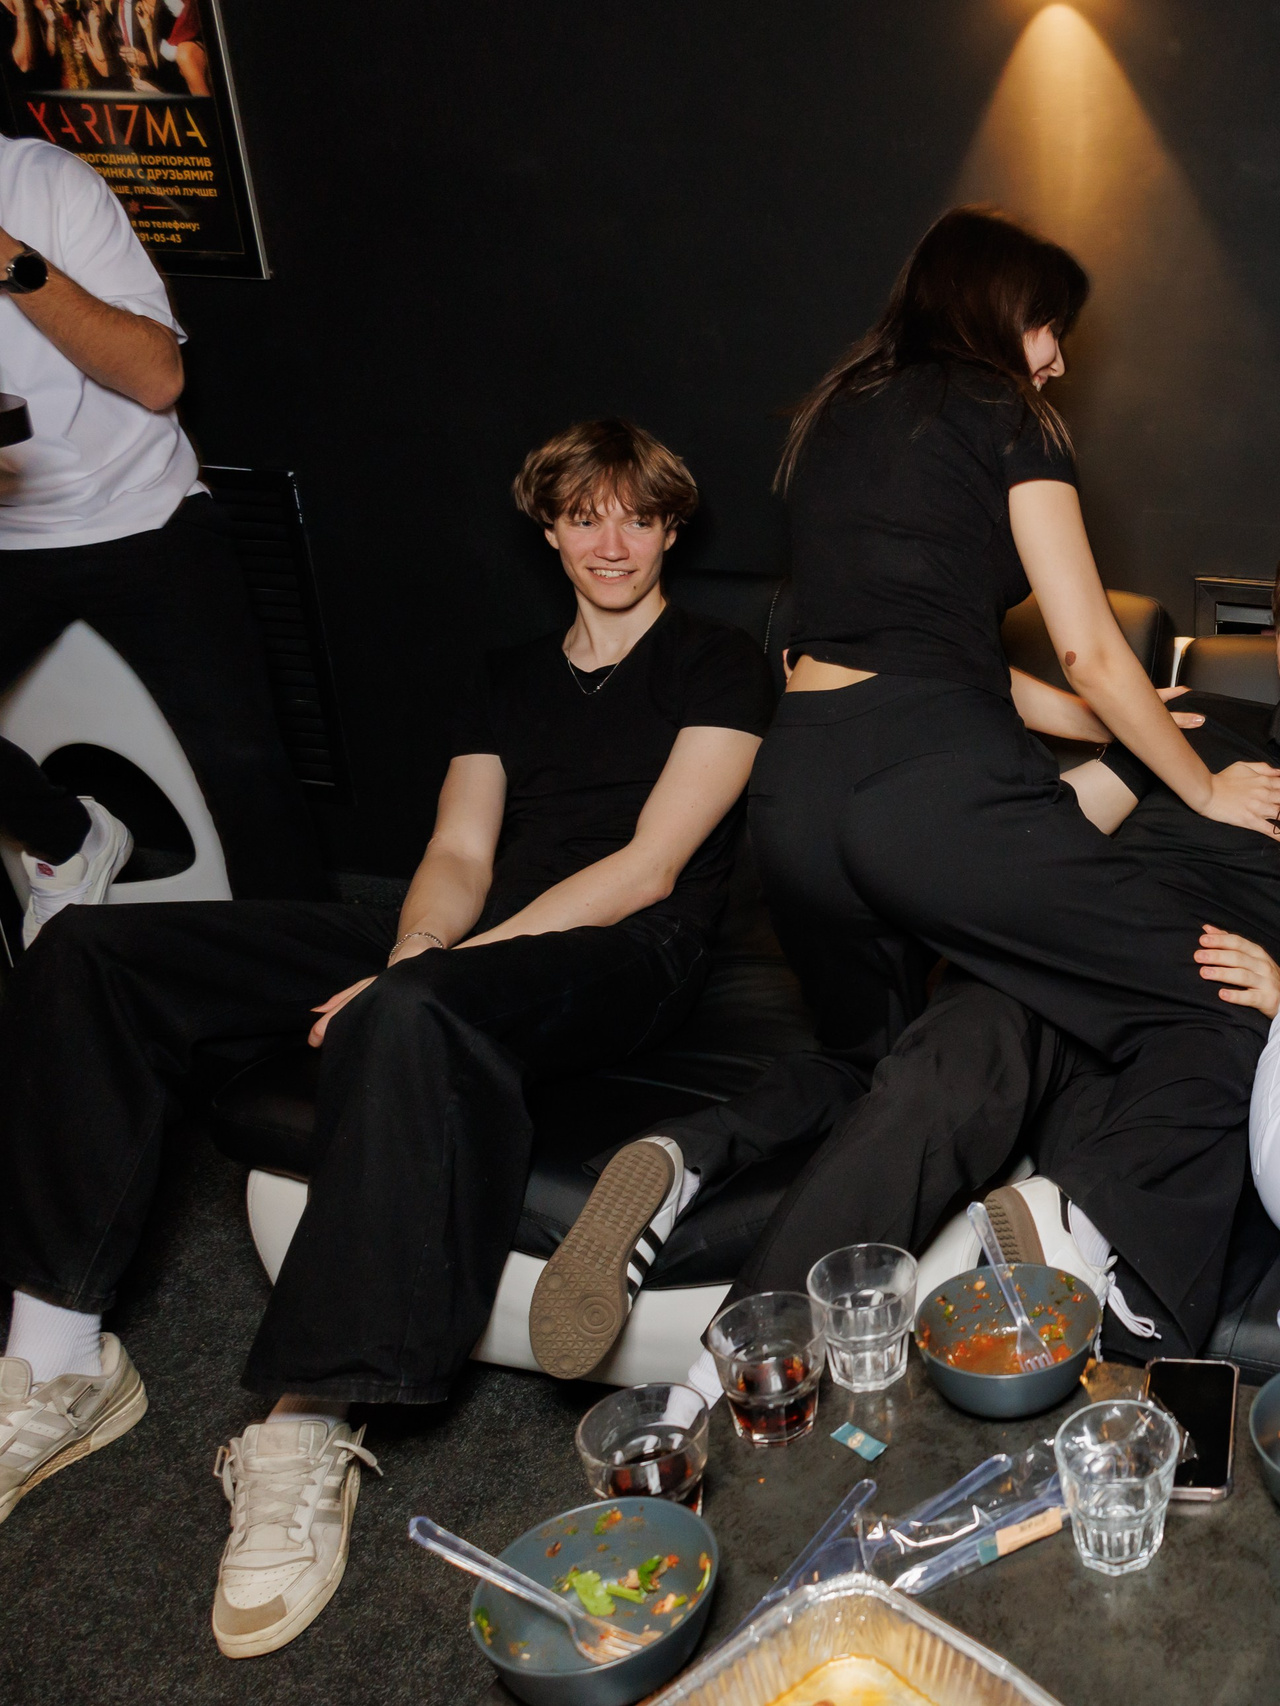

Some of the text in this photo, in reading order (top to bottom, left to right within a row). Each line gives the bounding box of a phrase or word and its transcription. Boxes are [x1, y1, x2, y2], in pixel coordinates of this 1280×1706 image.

[75, 152, 212, 167] ВОГОДНИЙ КОРПОРАТИВ
[136, 168, 145, 179] С
[146, 168, 214, 181] ДРУЗЬЯМИ?
[134, 185, 181, 197] ПРАЗДНУЙ
[182, 187, 218, 197] ЛУЧШЕ!
[138, 220, 151, 228] по
[151, 220, 200, 232] телефону:
[136, 232, 182, 243] 91-05-43
